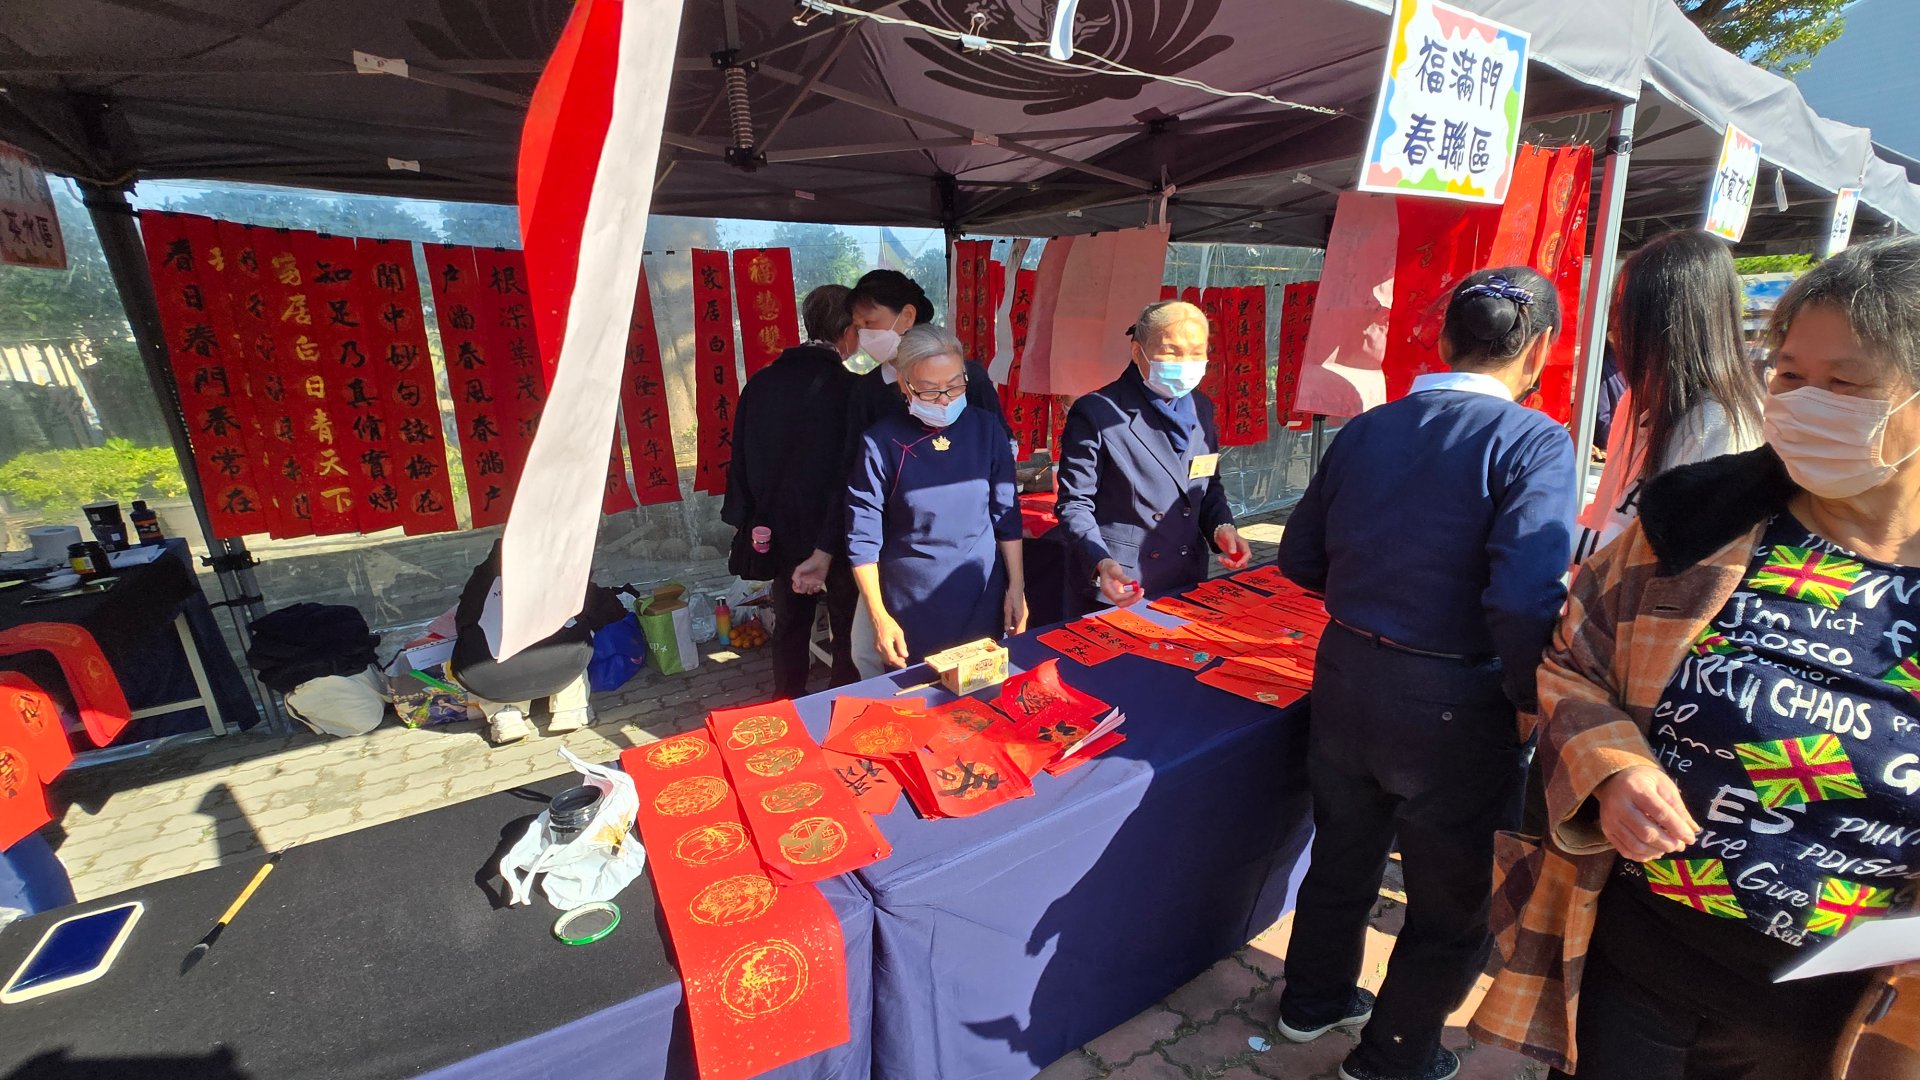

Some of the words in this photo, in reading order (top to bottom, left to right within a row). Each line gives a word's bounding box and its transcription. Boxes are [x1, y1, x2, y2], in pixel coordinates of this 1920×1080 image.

[1415, 35, 1503, 111] 福滿門
[1403, 113, 1492, 174] 春聯區
[749, 256, 784, 358] 福慧雙
[162, 238, 256, 515] 春日春門春常在
[1770, 677, 1873, 740] CHAOS
